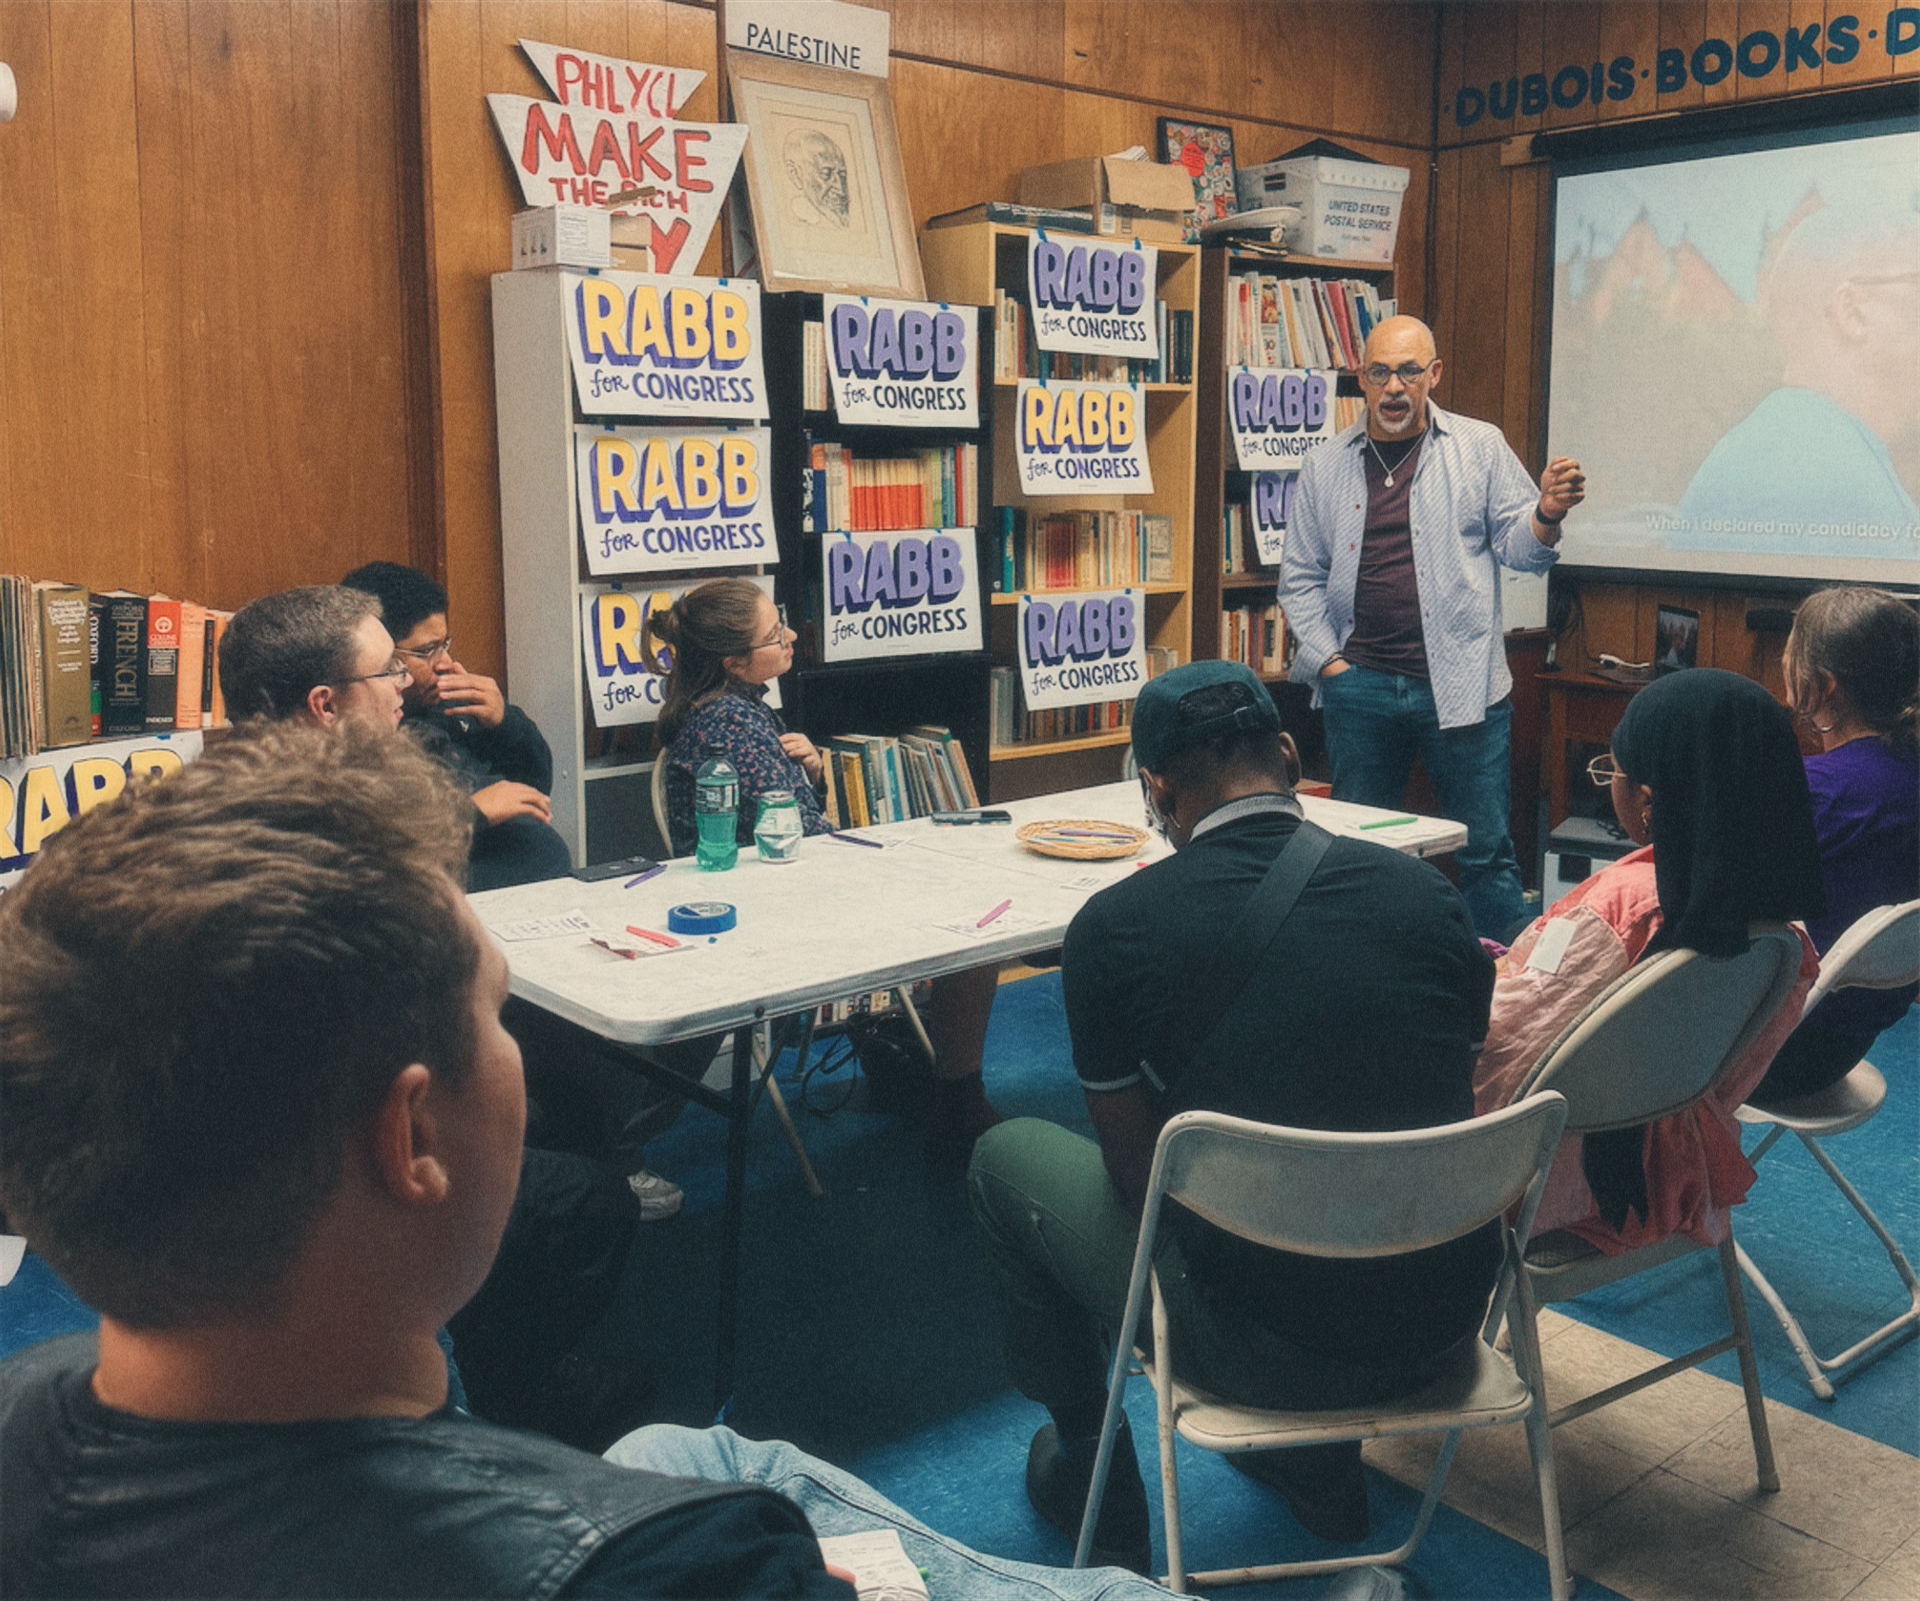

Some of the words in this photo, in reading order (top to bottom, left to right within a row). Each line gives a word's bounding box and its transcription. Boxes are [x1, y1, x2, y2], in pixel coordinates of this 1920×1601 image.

[747, 23, 862, 71] PALESTINE
[1455, 56, 1635, 127] DUBOIS
[1656, 15, 1860, 94] BOOKS
[521, 103, 714, 194] MAKE
[548, 177, 609, 207] THE
[621, 180, 688, 214] RCH
[1328, 201, 1358, 213] UNITED
[1359, 203, 1391, 216] STATES
[1324, 214, 1356, 228] POSTAL
[1358, 218, 1393, 232] SERVICE
[1034, 241, 1146, 315] RABB
[574, 279, 752, 371] RABB
[831, 303, 967, 381] RABB
[1066, 317, 1147, 342] CONGRESS
[632, 373, 755, 403] CONGRESS
[873, 385, 967, 411] CONGRESS
[1234, 373, 1328, 433] RABB
[1022, 387, 1136, 454] RABB
[1263, 437, 1328, 456] CONGRE
[589, 436, 759, 524] RABB
[1055, 458, 1140, 480] CONGRESS
[642, 523, 765, 554] CONGRESS
[1646, 515, 1690, 531] When
[1704, 517, 1776, 534] declared
[1780, 522, 1803, 537] my
[1808, 520, 1901, 541] candidacy
[829, 535, 965, 616] RABB
[861, 608, 968, 640] CONGRESS
[1024, 596, 1136, 668] RABB
[115, 621, 138, 697] FRENCH
[1058, 661, 1139, 690] CONGRESS
